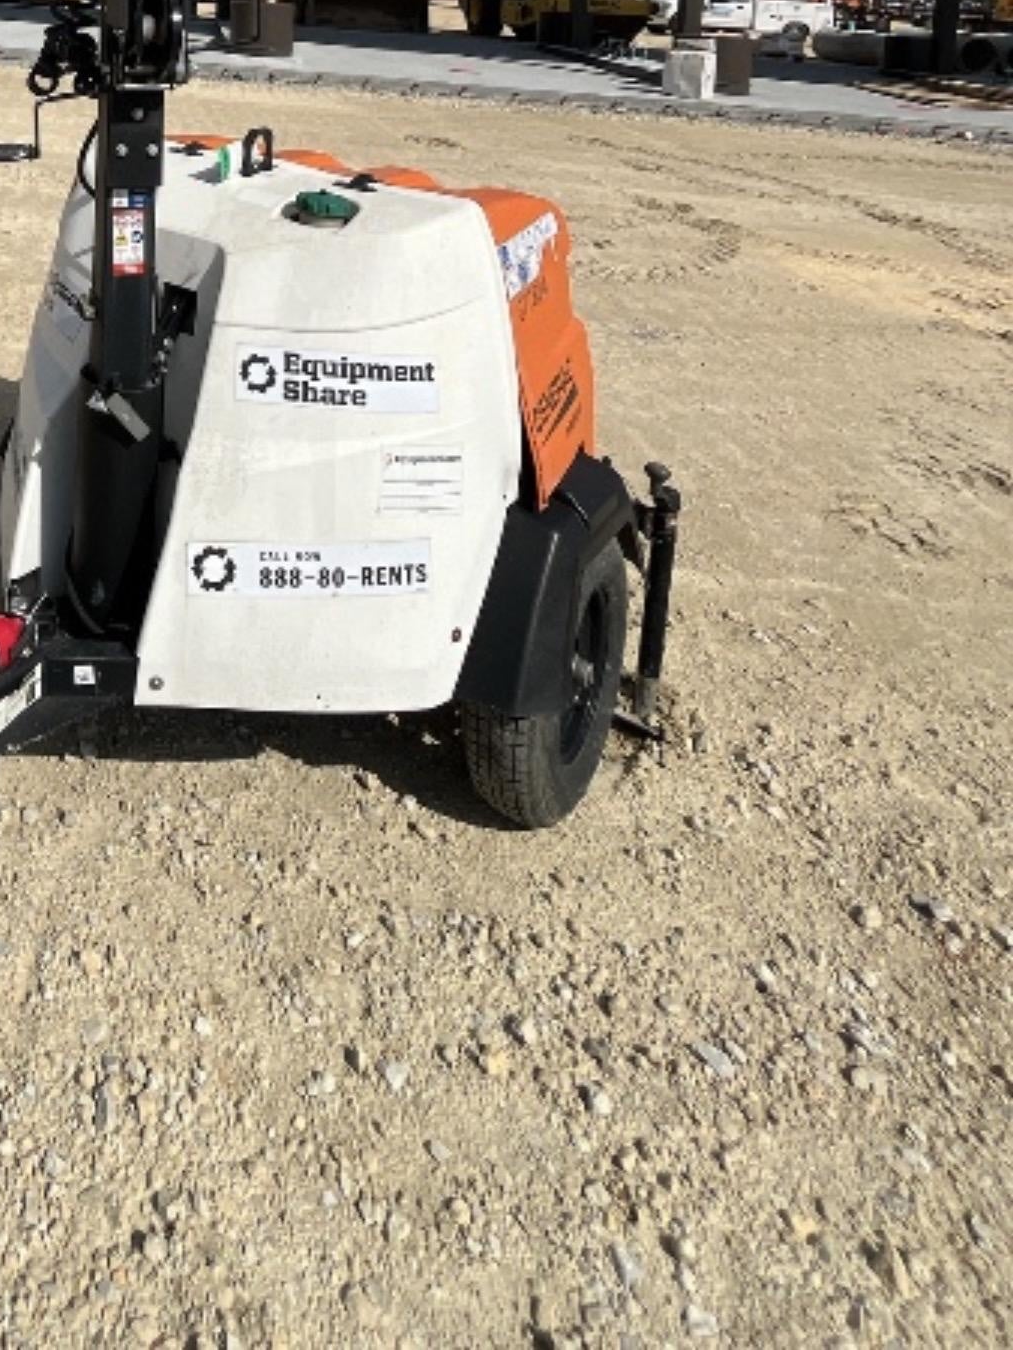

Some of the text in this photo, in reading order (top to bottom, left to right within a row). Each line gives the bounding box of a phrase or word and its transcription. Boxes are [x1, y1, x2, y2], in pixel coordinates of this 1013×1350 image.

[283, 351, 435, 384] Equipment
[282, 380, 367, 406] Share
[259, 563, 427, 589] 888-80-RENTS
